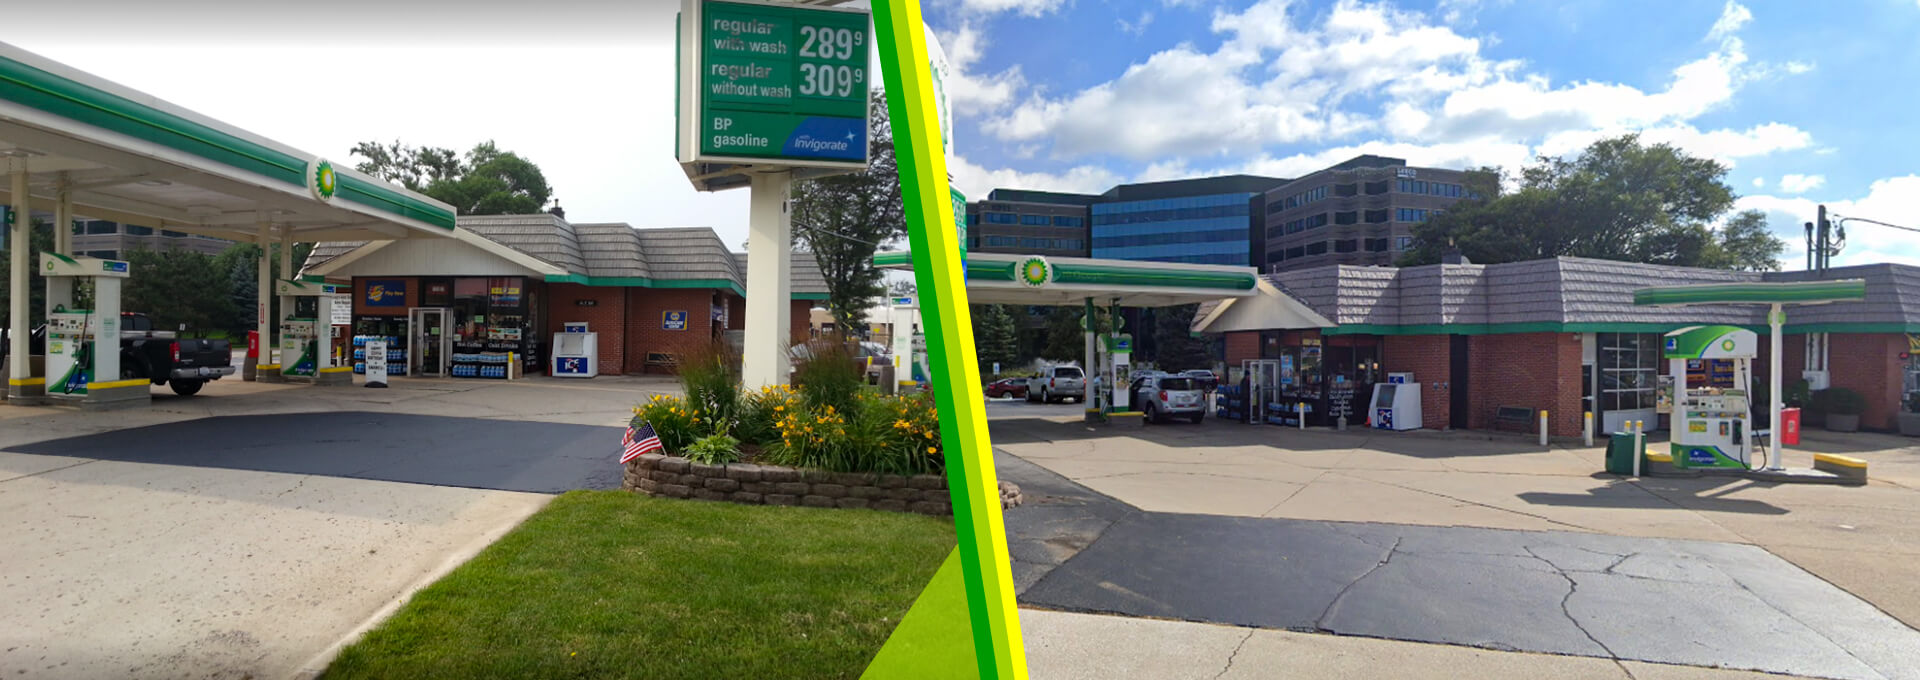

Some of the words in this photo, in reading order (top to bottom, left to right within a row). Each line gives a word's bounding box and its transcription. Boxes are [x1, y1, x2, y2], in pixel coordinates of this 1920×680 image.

[714, 18, 776, 35] regular
[713, 36, 745, 51] with
[749, 40, 787, 54] wash
[799, 25, 853, 60] 289
[854, 31, 863, 46] 9
[711, 62, 773, 80] regular
[799, 62, 852, 98] 309
[854, 68, 863, 84] 9
[711, 80, 757, 97] without
[760, 84, 792, 98] wash
[713, 117, 733, 130] BP
[713, 133, 769, 149] gasoline
[794, 138, 848, 152] Invigorate
[564, 358, 580, 371] ICE
